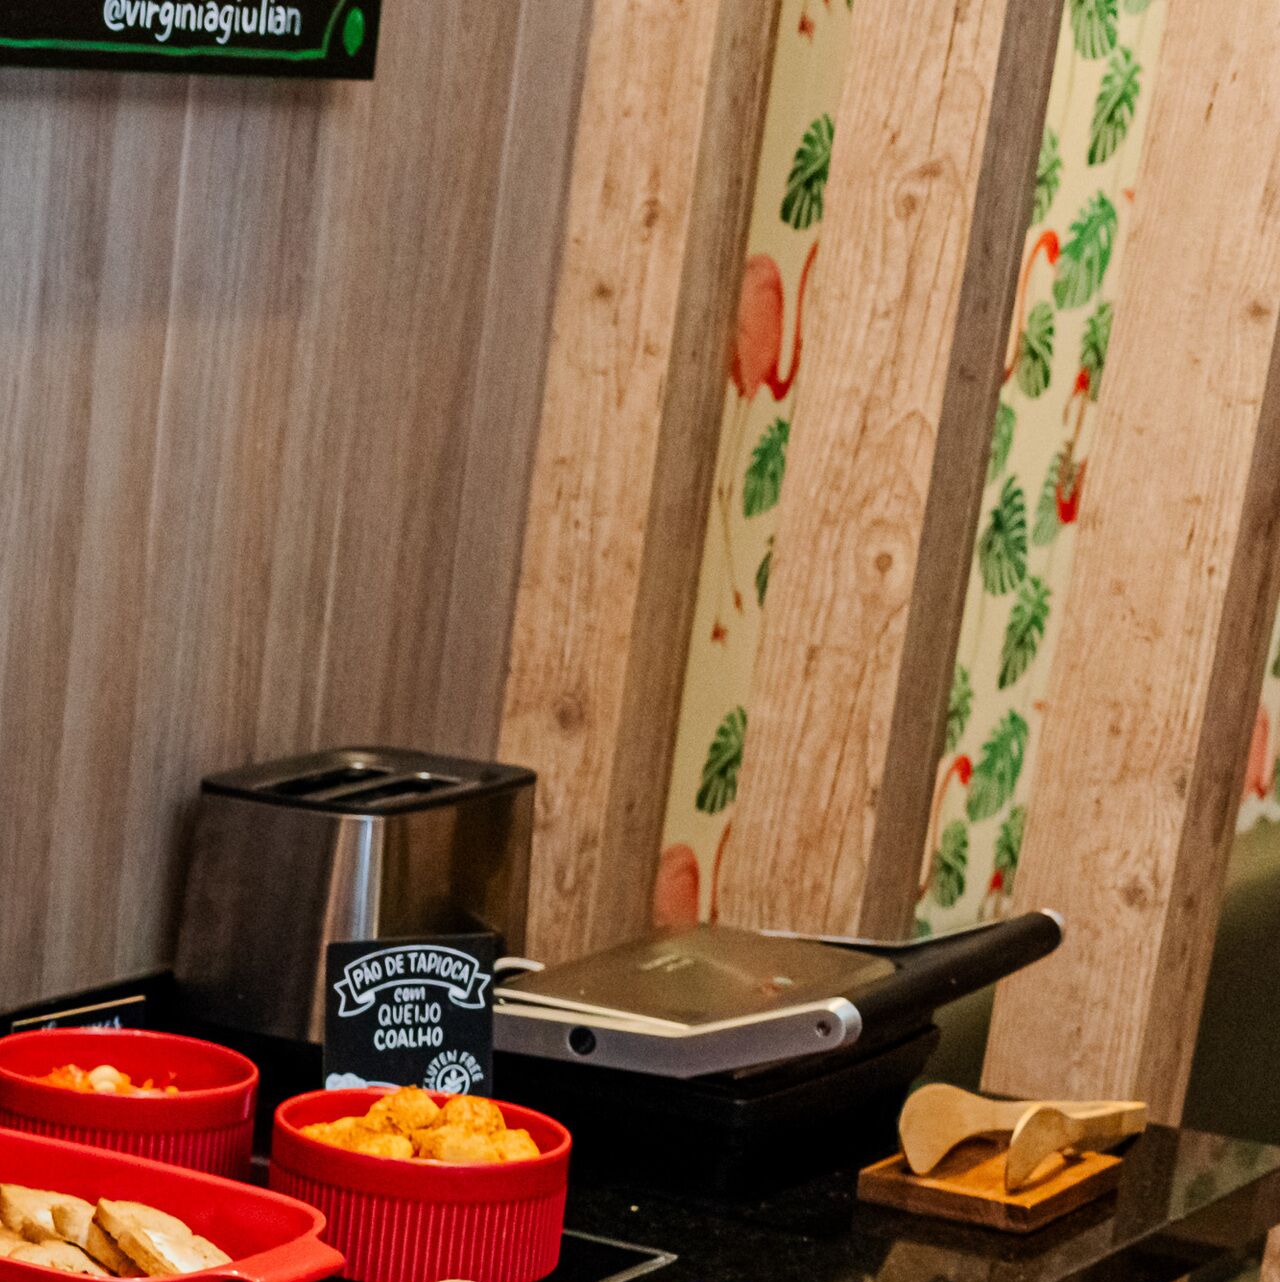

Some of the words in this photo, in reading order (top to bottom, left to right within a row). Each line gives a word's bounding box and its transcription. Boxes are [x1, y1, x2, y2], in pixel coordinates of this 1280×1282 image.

[352, 960, 383, 990] PÃO
[384, 953, 406, 977] DE
[407, 952, 471, 984] TAPIOCA
[393, 986, 426, 1003] com
[378, 1002, 442, 1026] QUEIJO
[373, 1026, 444, 1051] COALHO
